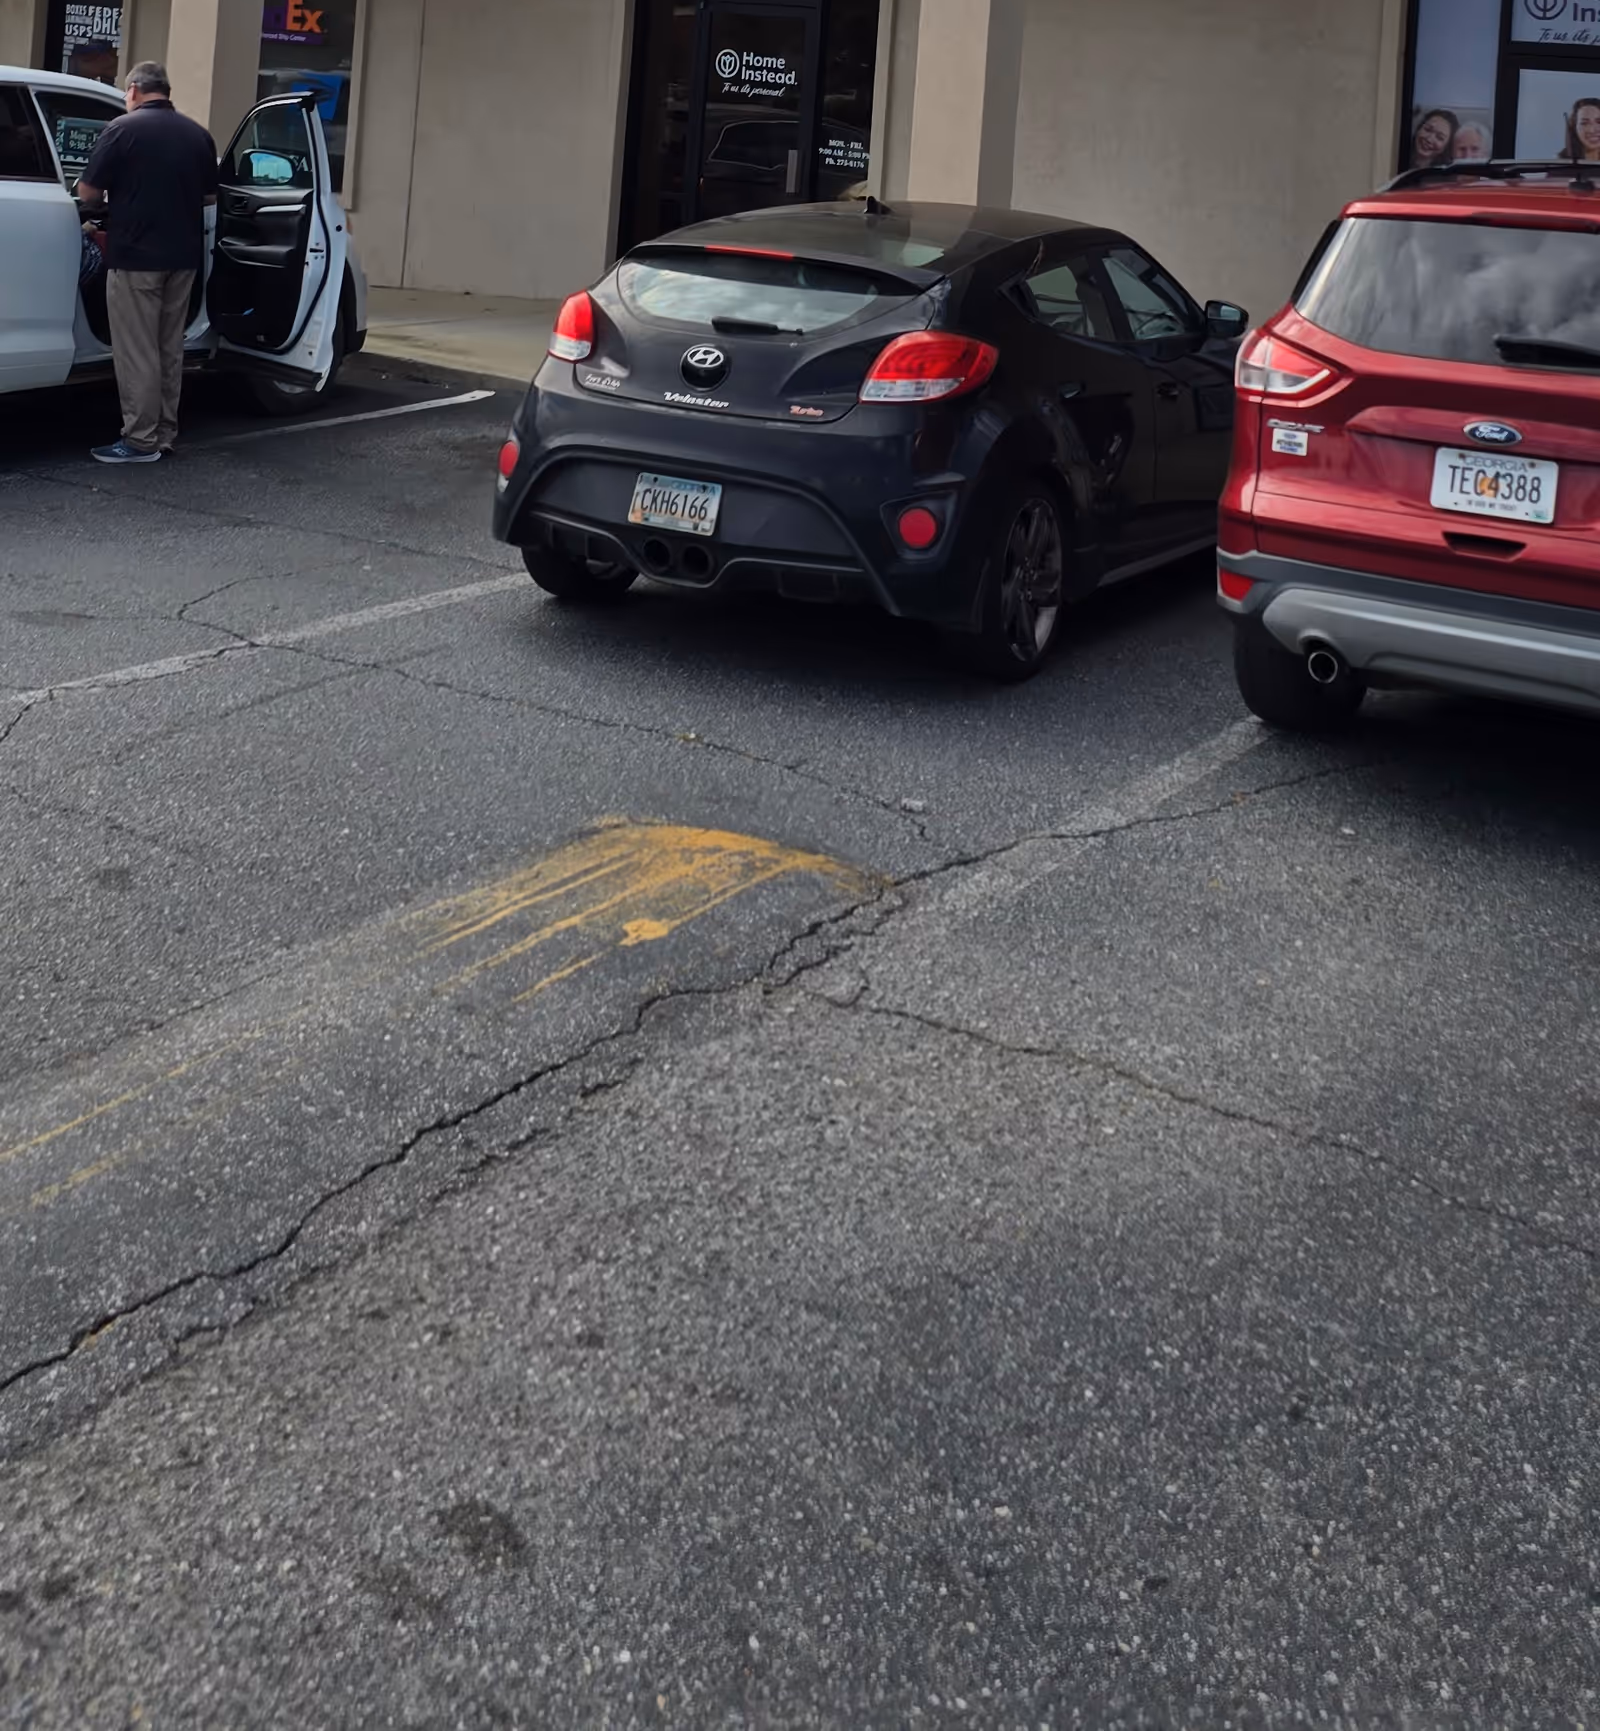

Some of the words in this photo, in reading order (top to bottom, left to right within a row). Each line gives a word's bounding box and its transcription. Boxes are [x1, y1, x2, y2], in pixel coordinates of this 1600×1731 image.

[66, 4, 87, 16] BOXES
[65, 24, 92, 37] USPS
[93, 18, 117, 35] DHL
[742, 51, 786, 69] Home
[664, 392, 729, 408] Veloster
[1475, 426, 1509, 441] Ford
[1463, 455, 1529, 473] GEORGIA
[641, 488, 709, 521] CKH6166
